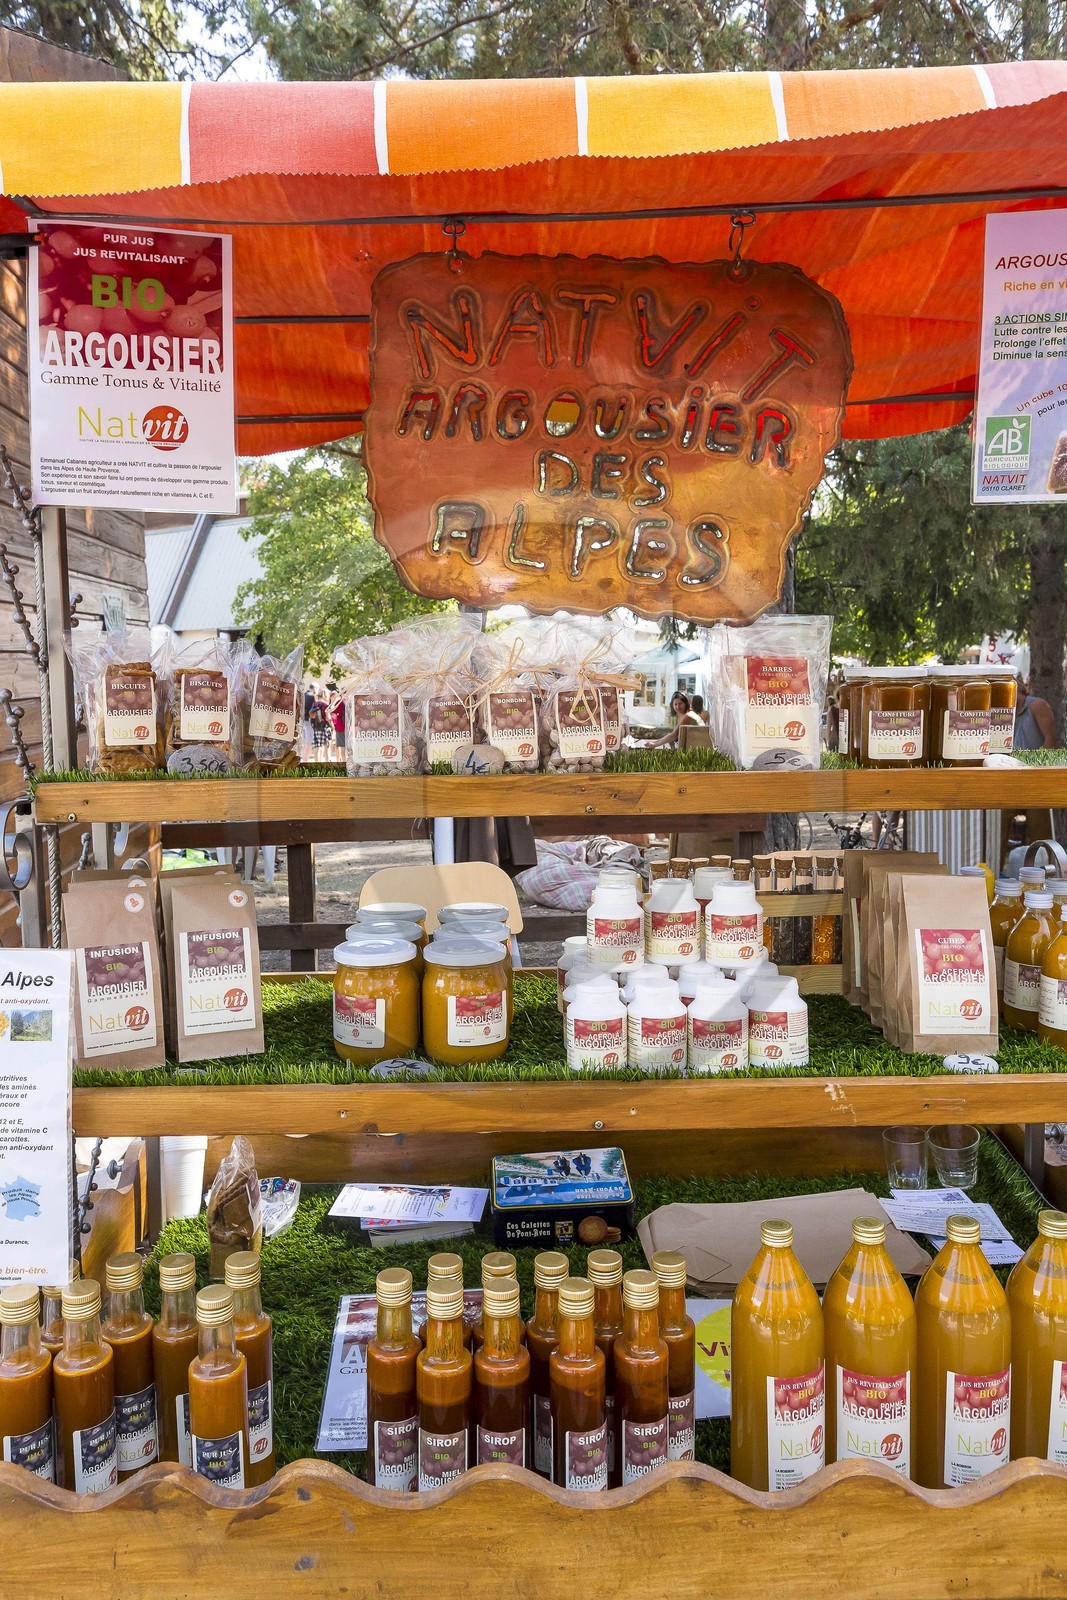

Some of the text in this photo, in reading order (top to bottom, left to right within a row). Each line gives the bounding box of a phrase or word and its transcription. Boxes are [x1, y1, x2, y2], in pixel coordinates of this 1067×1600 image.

[103, 233, 154, 246] PUR JUS
[73, 247, 185, 264] JUS REVITALISANT
[1004, 281, 1054, 292] Riche en
[91, 274, 165, 312] BIO
[994, 313, 1051, 324] 3 ACTIONS
[994, 327, 1018, 336] Lutte
[1021, 326, 1051, 335] contre
[994, 337, 1066, 349] Prolonge l'effet
[41, 329, 224, 374] ARGOUSIER
[993, 350, 1043, 360] Diminue la
[40, 371, 221, 393] Gamme Tonus & Vitalité
[1017, 390, 1054, 412] Un cube
[1037, 404, 1056, 418] pour
[987, 428, 1023, 454] AB
[537, 450, 667, 507] DES
[982, 474, 1027, 485] NATVIT
[431, 501, 728, 587] ALPES
[189, 680, 223, 688] BISCUITS
[107, 708, 153, 717] ARGOUSIER
[184, 705, 228, 713] ARGOUSIER
[356, 730, 399, 739] ARGOUSIER
[430, 730, 471, 740] ARGOUSIER
[493, 727, 534, 738] ARGOUSIER
[562, 725, 601, 735] ARGOUSIER
[464, 750, 490, 774] 4€
[667, 914, 683, 923] BIO
[726, 917, 742, 926] BIO
[193, 931, 239, 942] INFUSION
[652, 929, 696, 939] ARGOUSIER
[712, 932, 758, 941] ARGOUSIER
[91, 946, 139, 959] INFUSION
[206, 946, 224, 954] BIO
[942, 953, 964, 962] BIO
[106, 962, 124, 971] BIO
[190, 964, 246, 979] ARGOUSIER
[0, 971, 54, 990] Alpes
[924, 974, 986, 983] ARGOUSIER
[89, 980, 148, 997] ARGOUSIER
[860, 1380, 903, 1389] REVITALISANT
[798, 1387, 815, 1399] BIO
[866, 1390, 886, 1400] BIO
[980, 1388, 997, 1398] BIO
[139, 1400, 151, 1411] JUS
[843, 1401, 907, 1420] ARGOUSIER
[881, 1400, 904, 1410] POMME
[129, 1411, 146, 1422] BIO
[116, 1422, 156, 1440] ARGOUSIER
[634, 1424, 664, 1436] SIROP
[427, 1436, 459, 1447] SIROP
[485, 1435, 516, 1446] SIROP
[578, 1429, 605, 1445] SIROP
[587, 1448, 600, 1457] BIO
[442, 1470, 461, 1478] MIEL
